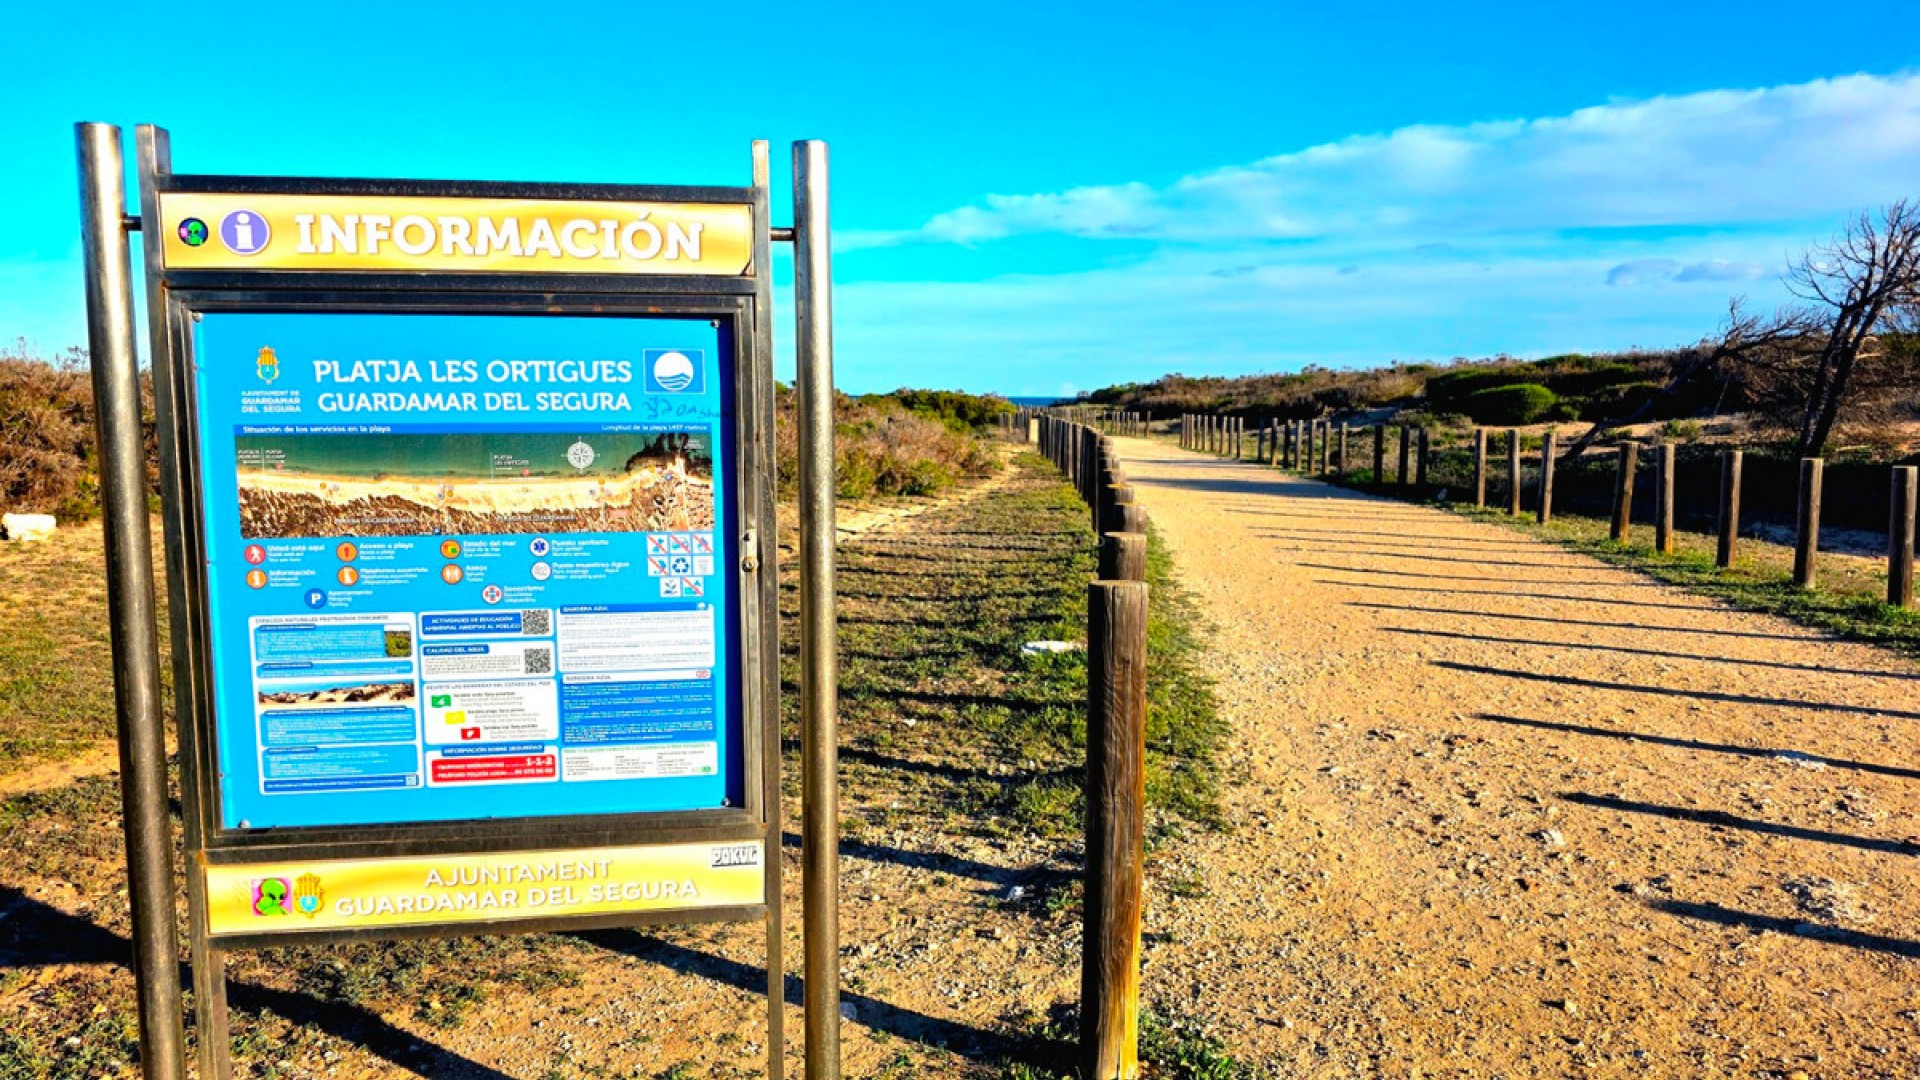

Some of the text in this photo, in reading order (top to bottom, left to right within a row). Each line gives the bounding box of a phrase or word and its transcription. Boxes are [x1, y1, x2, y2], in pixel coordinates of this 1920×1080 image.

[295, 212, 703, 261] INFORMACIÓN
[313, 360, 632, 383] PLATJA LES ORTIGUES
[241, 397, 301, 405] GUARDAMAR
[241, 405, 302, 413] DEL SEGURA
[318, 392, 631, 412] GUARDAMAR DEL SEGURA
[243, 425, 281, 433] Situación
[284, 425, 294, 433] de
[295, 425, 308, 433] los
[310, 425, 347, 433] servicios
[347, 425, 358, 433] en
[369, 425, 391, 434] playa
[425, 860, 612, 888] AJUNTAMENT
[335, 879, 699, 917] GUARDAMAR DEL SEGURA
